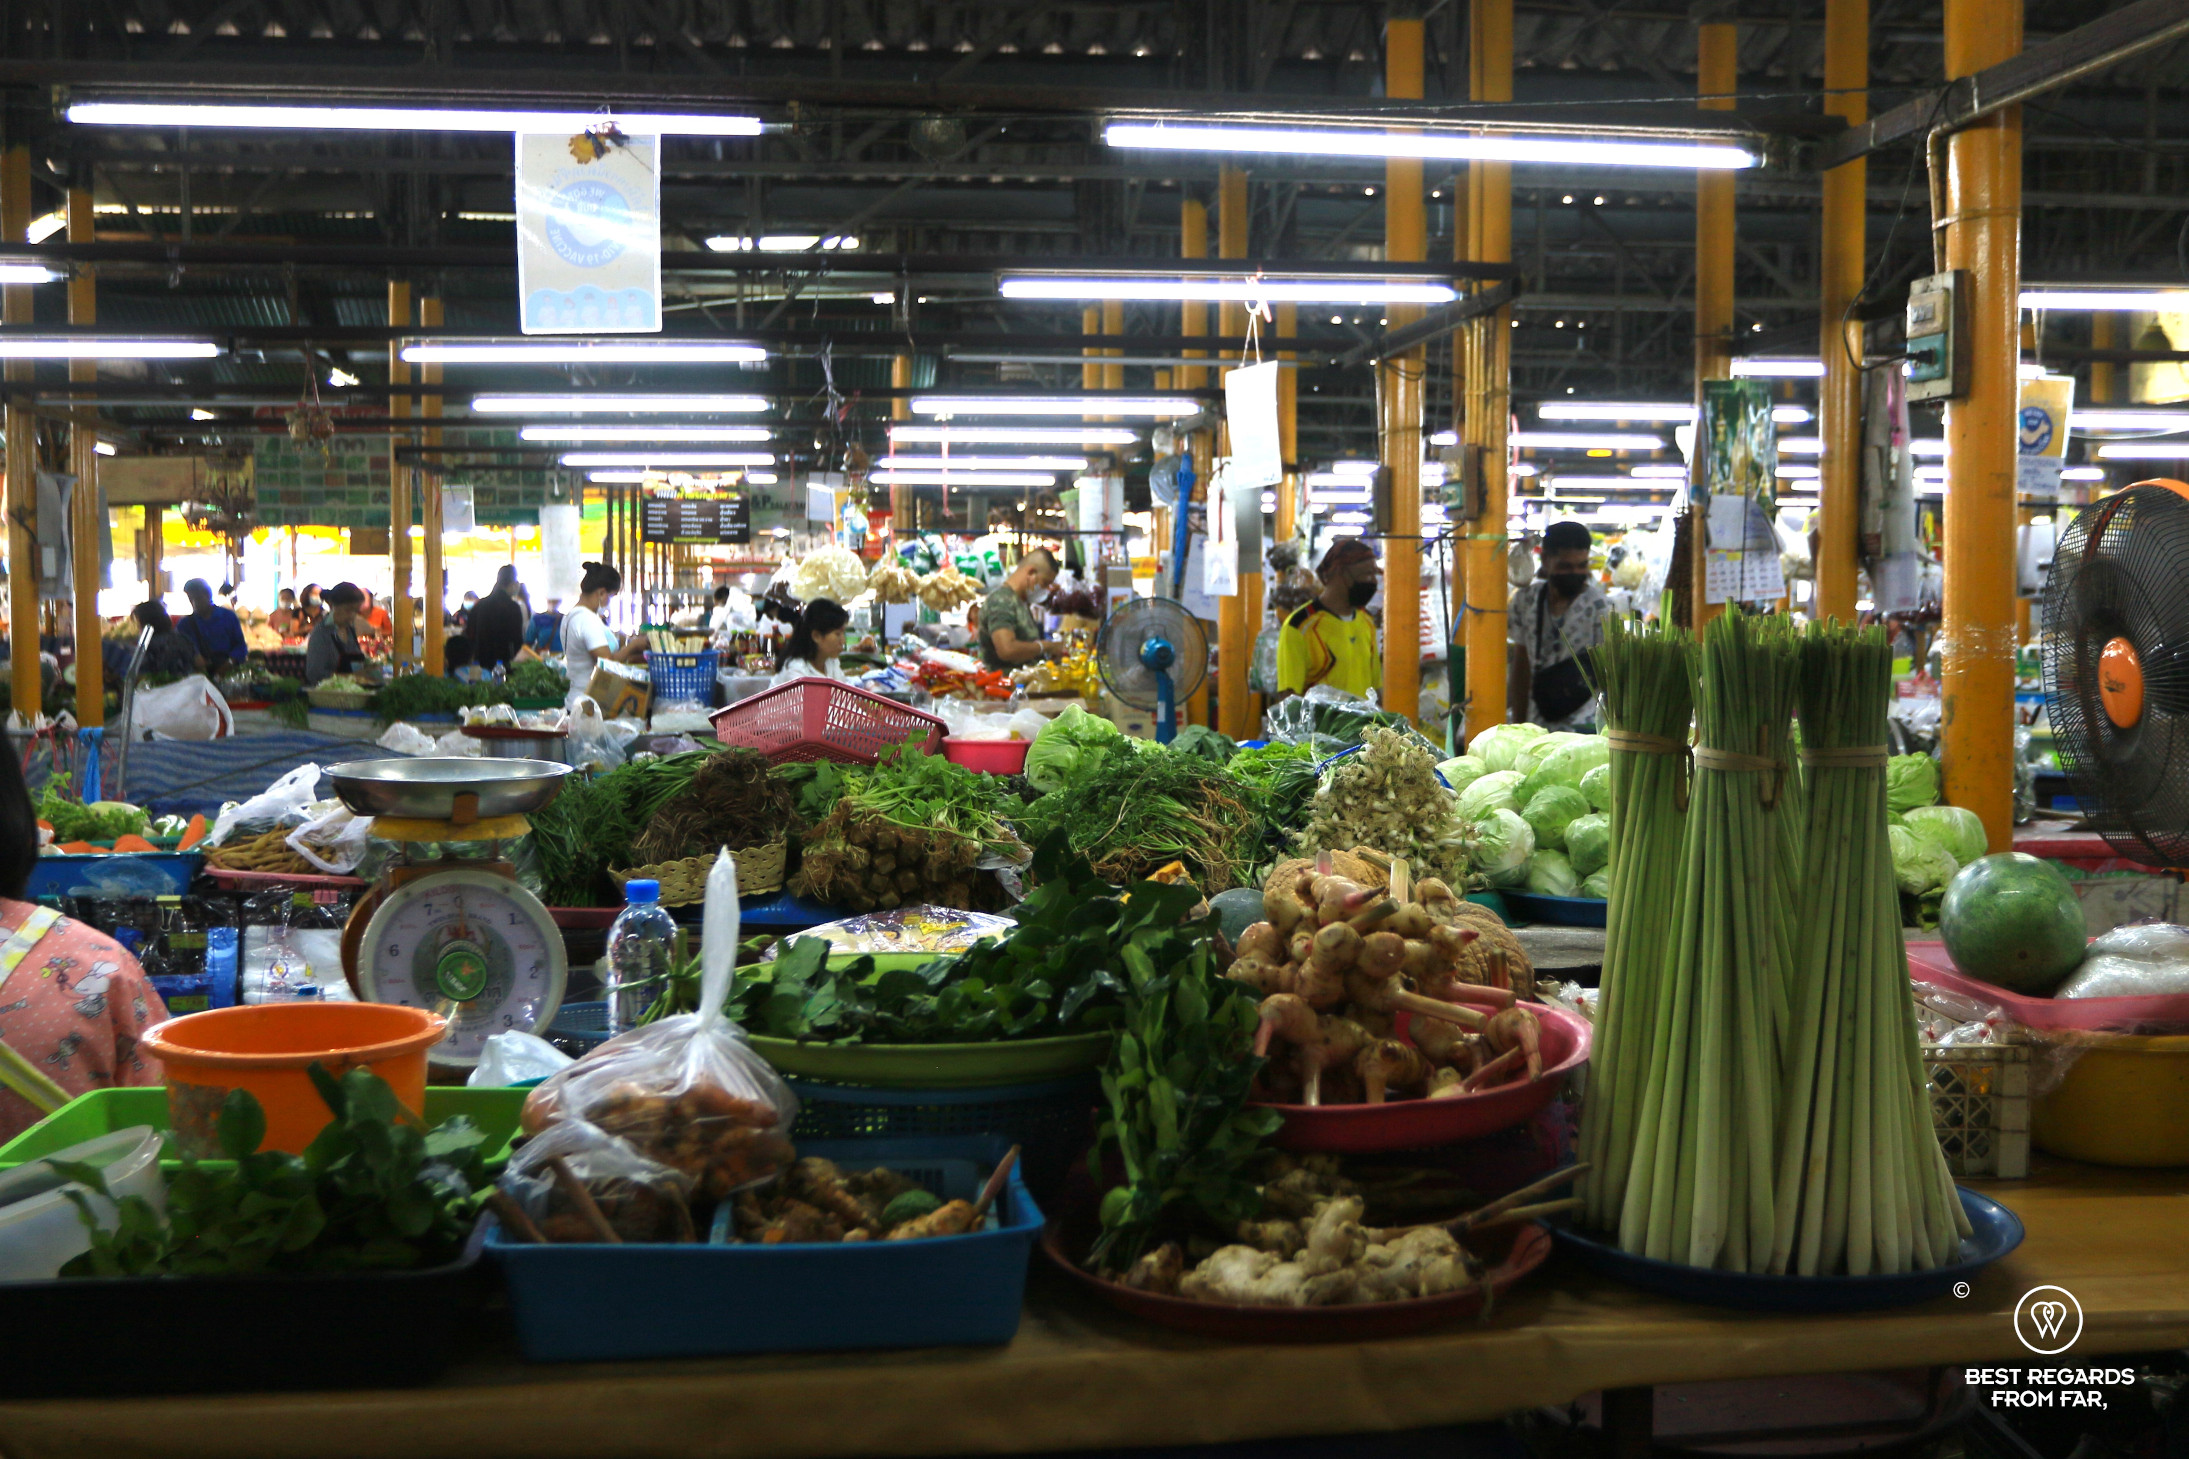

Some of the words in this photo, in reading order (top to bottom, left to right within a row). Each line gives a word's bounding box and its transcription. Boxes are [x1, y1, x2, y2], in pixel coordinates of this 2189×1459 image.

[389, 944, 399, 957] 6
[529, 965, 539, 979] 2
[503, 1014, 514, 1027] 3
